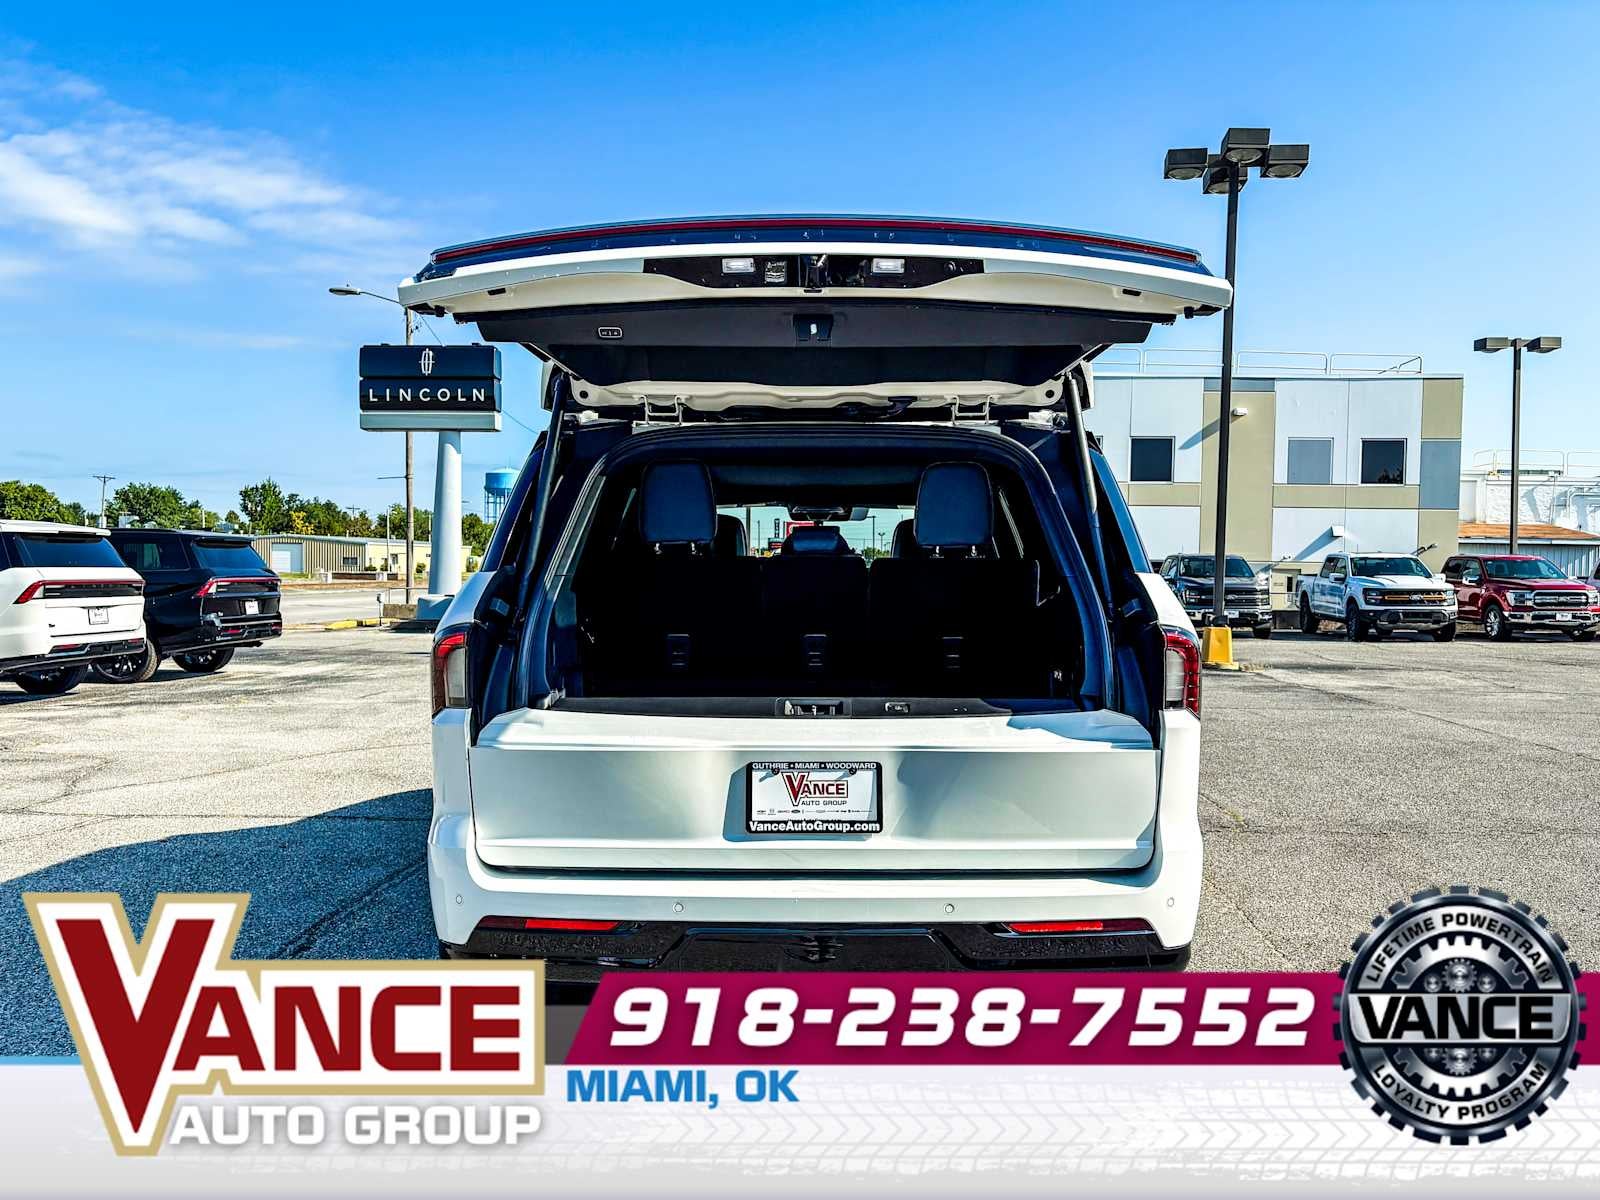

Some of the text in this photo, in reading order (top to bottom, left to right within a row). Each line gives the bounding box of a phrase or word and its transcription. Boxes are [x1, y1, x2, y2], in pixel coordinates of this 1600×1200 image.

[368, 387, 486, 402] LINCOLN
[752, 762, 877, 770] GUTHRIE MIAMI WOODWARD
[784, 773, 846, 802] VANCE
[749, 821, 881, 833] VanceAutoGroup.com
